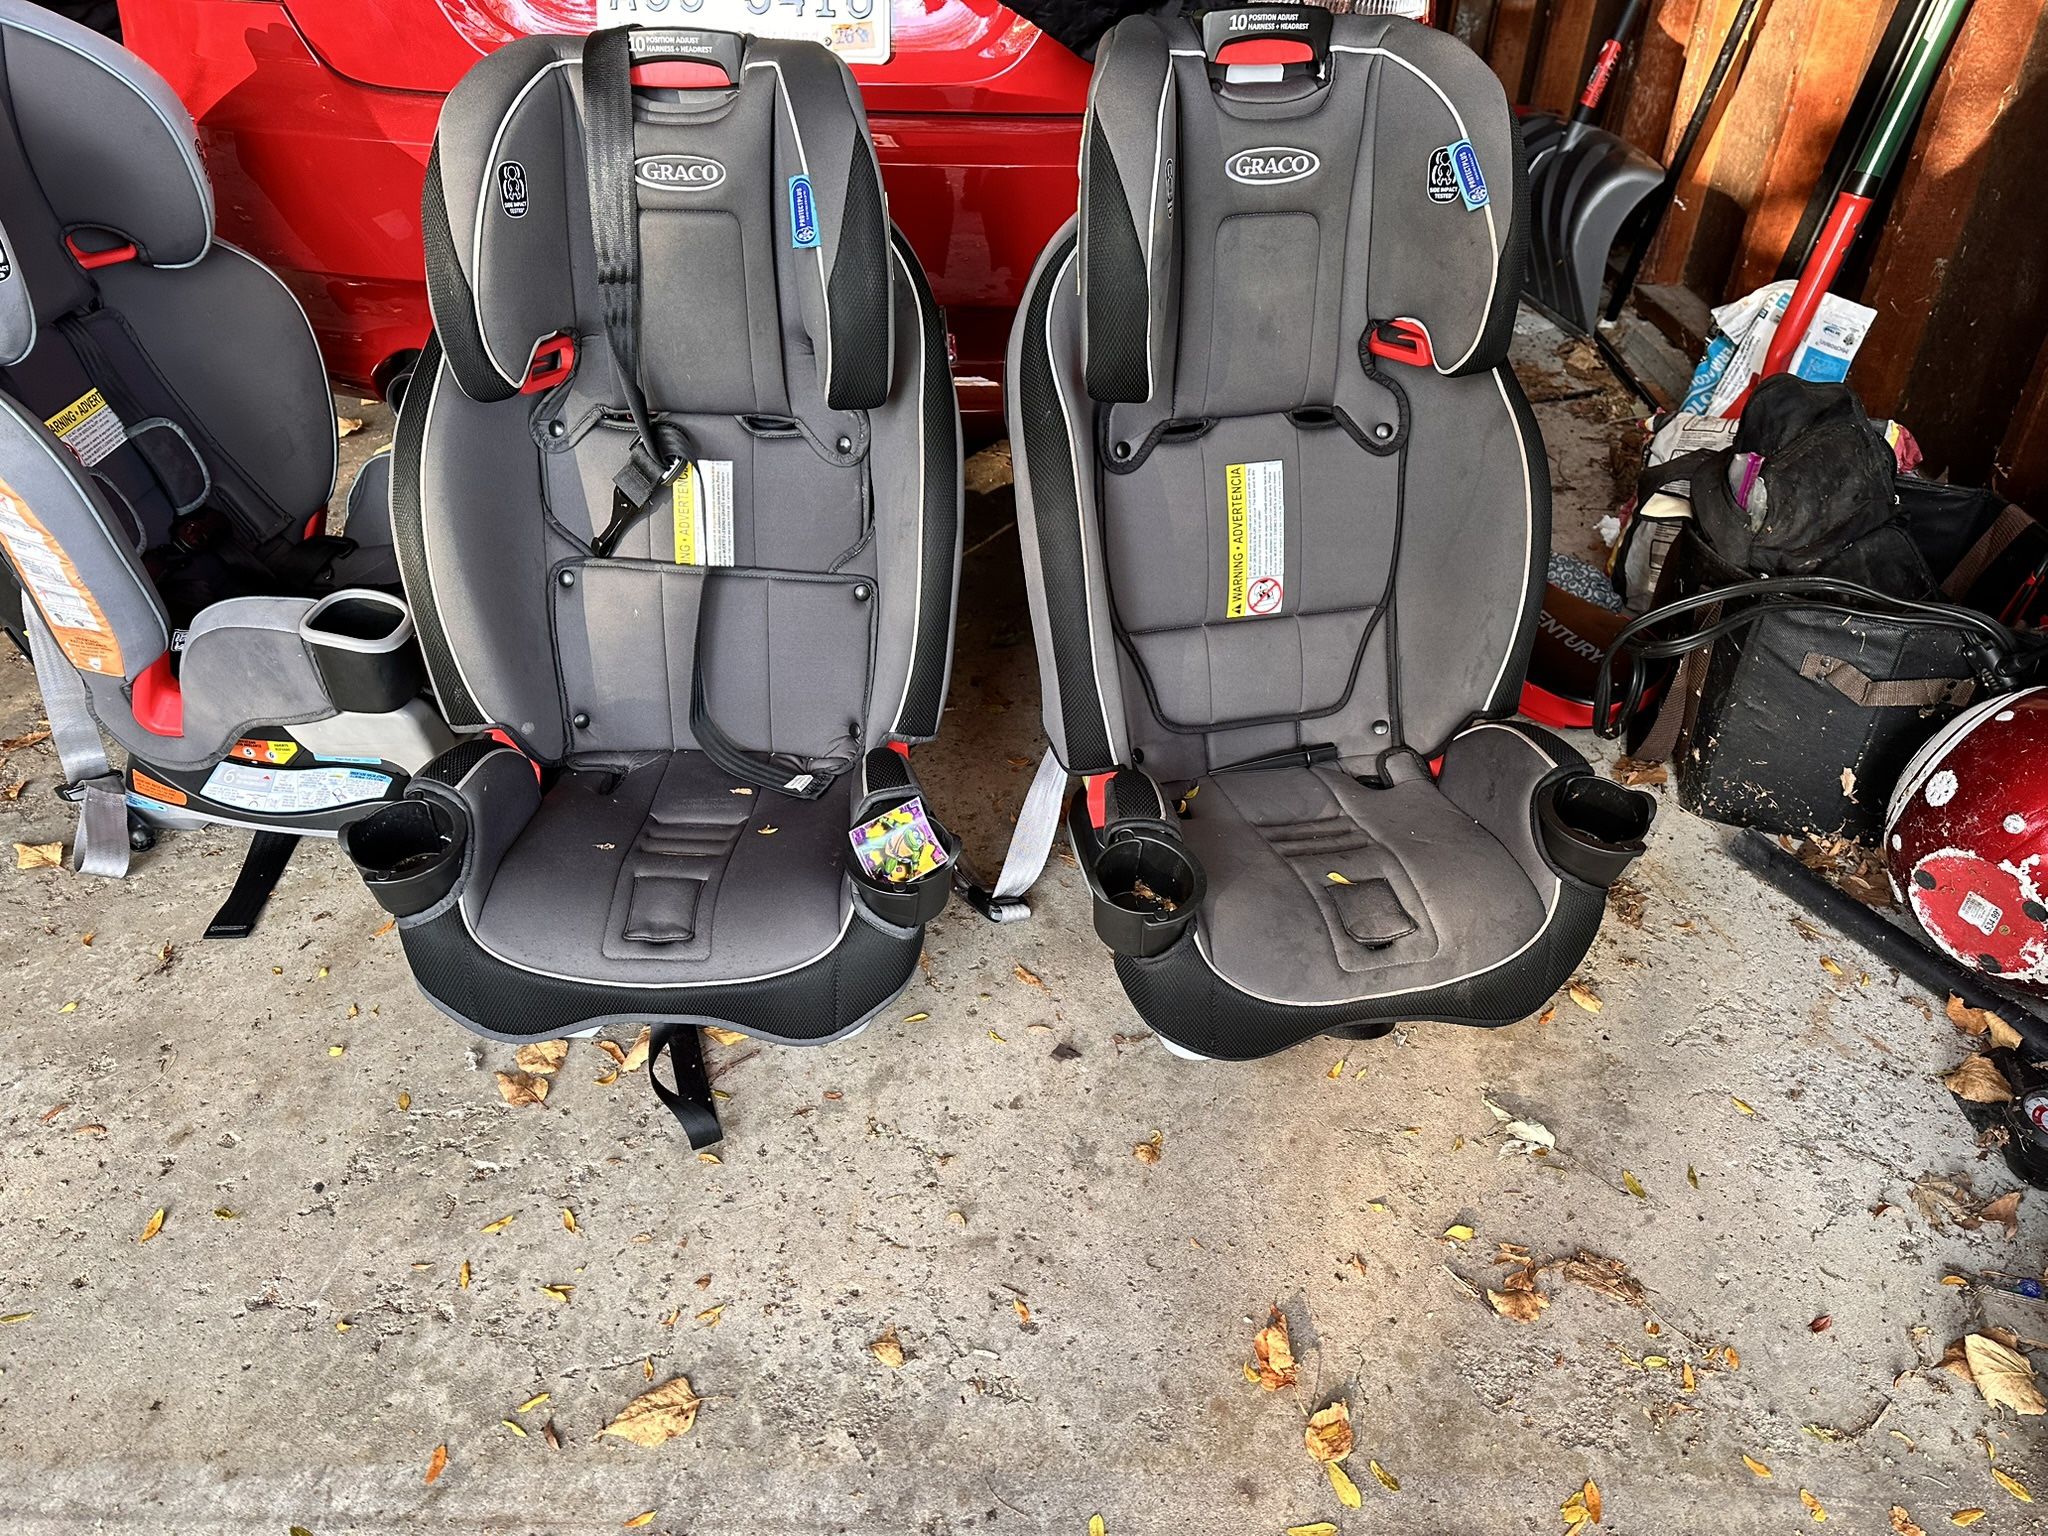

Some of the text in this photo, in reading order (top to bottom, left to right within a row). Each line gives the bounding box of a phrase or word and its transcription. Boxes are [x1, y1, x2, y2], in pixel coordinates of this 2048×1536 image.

[1229, 14, 1247, 31] 10
[1248, 13, 1299, 21] POSITION ADJUST
[1248, 22, 1275, 30] HARNESS
[1280, 22, 1310, 30] HEADREST
[628, 35, 646, 52] 10
[645, 36, 675, 44] POSITION
[646, 45, 675, 53] HARNESS
[641, 161, 719, 182] GRACO
[1235, 155, 1310, 177] GRACO
[677, 465, 691, 566] ING ADVERTENC
[1230, 466, 1244, 603] WARNING ADVERTENCIA
